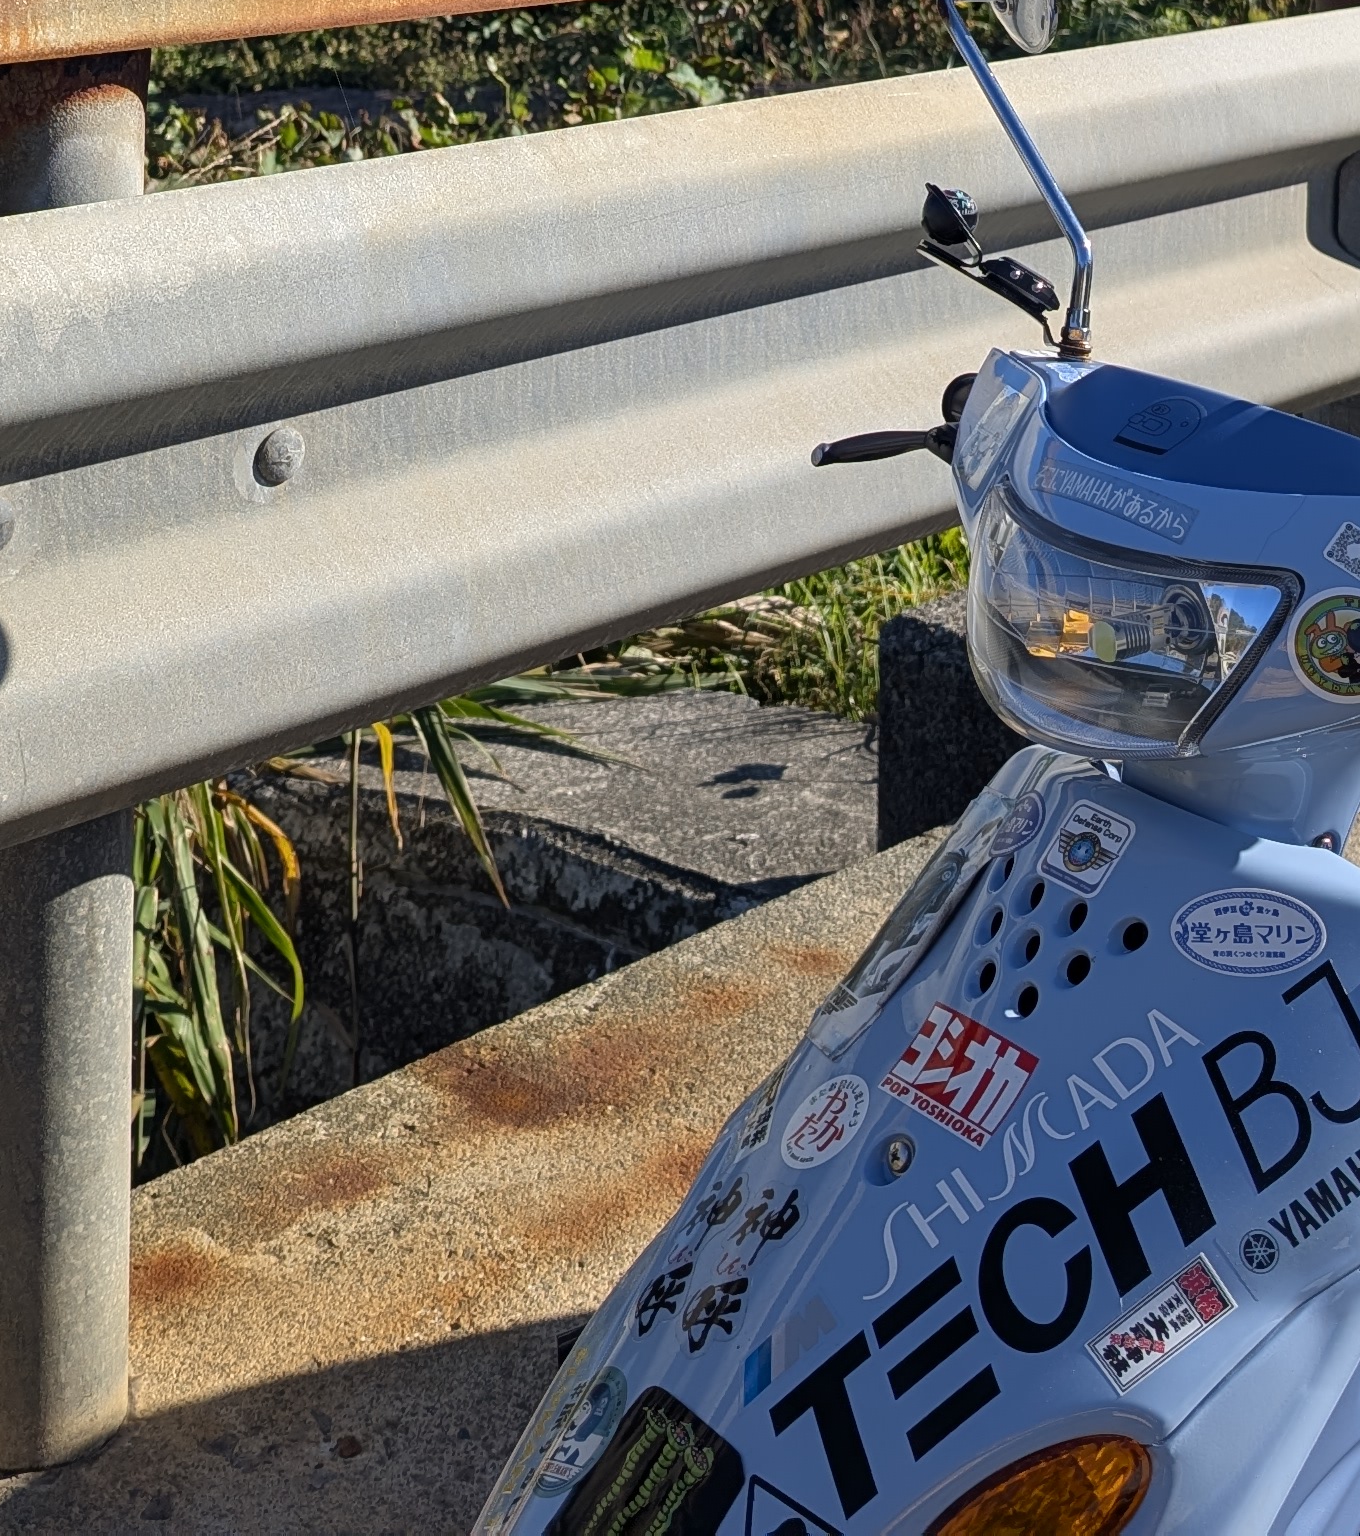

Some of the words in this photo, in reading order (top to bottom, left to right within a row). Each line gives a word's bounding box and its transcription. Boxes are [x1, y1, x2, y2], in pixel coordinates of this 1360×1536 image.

[1033, 465, 1190, 540] そこにYAMAHAがあるから
[1072, 814, 1103, 834] Defense
[1103, 828, 1123, 843] Corp
[1090, 813, 1112, 829] Earth
[891, 1005, 1031, 1134] ヨシオカ
[880, 1076, 911, 1098] POP
[910, 1092, 986, 1147] YOSHIOKA
[768, 1091, 1217, 1521] TECH
[1178, 1264, 1224, 1322] 浜松
